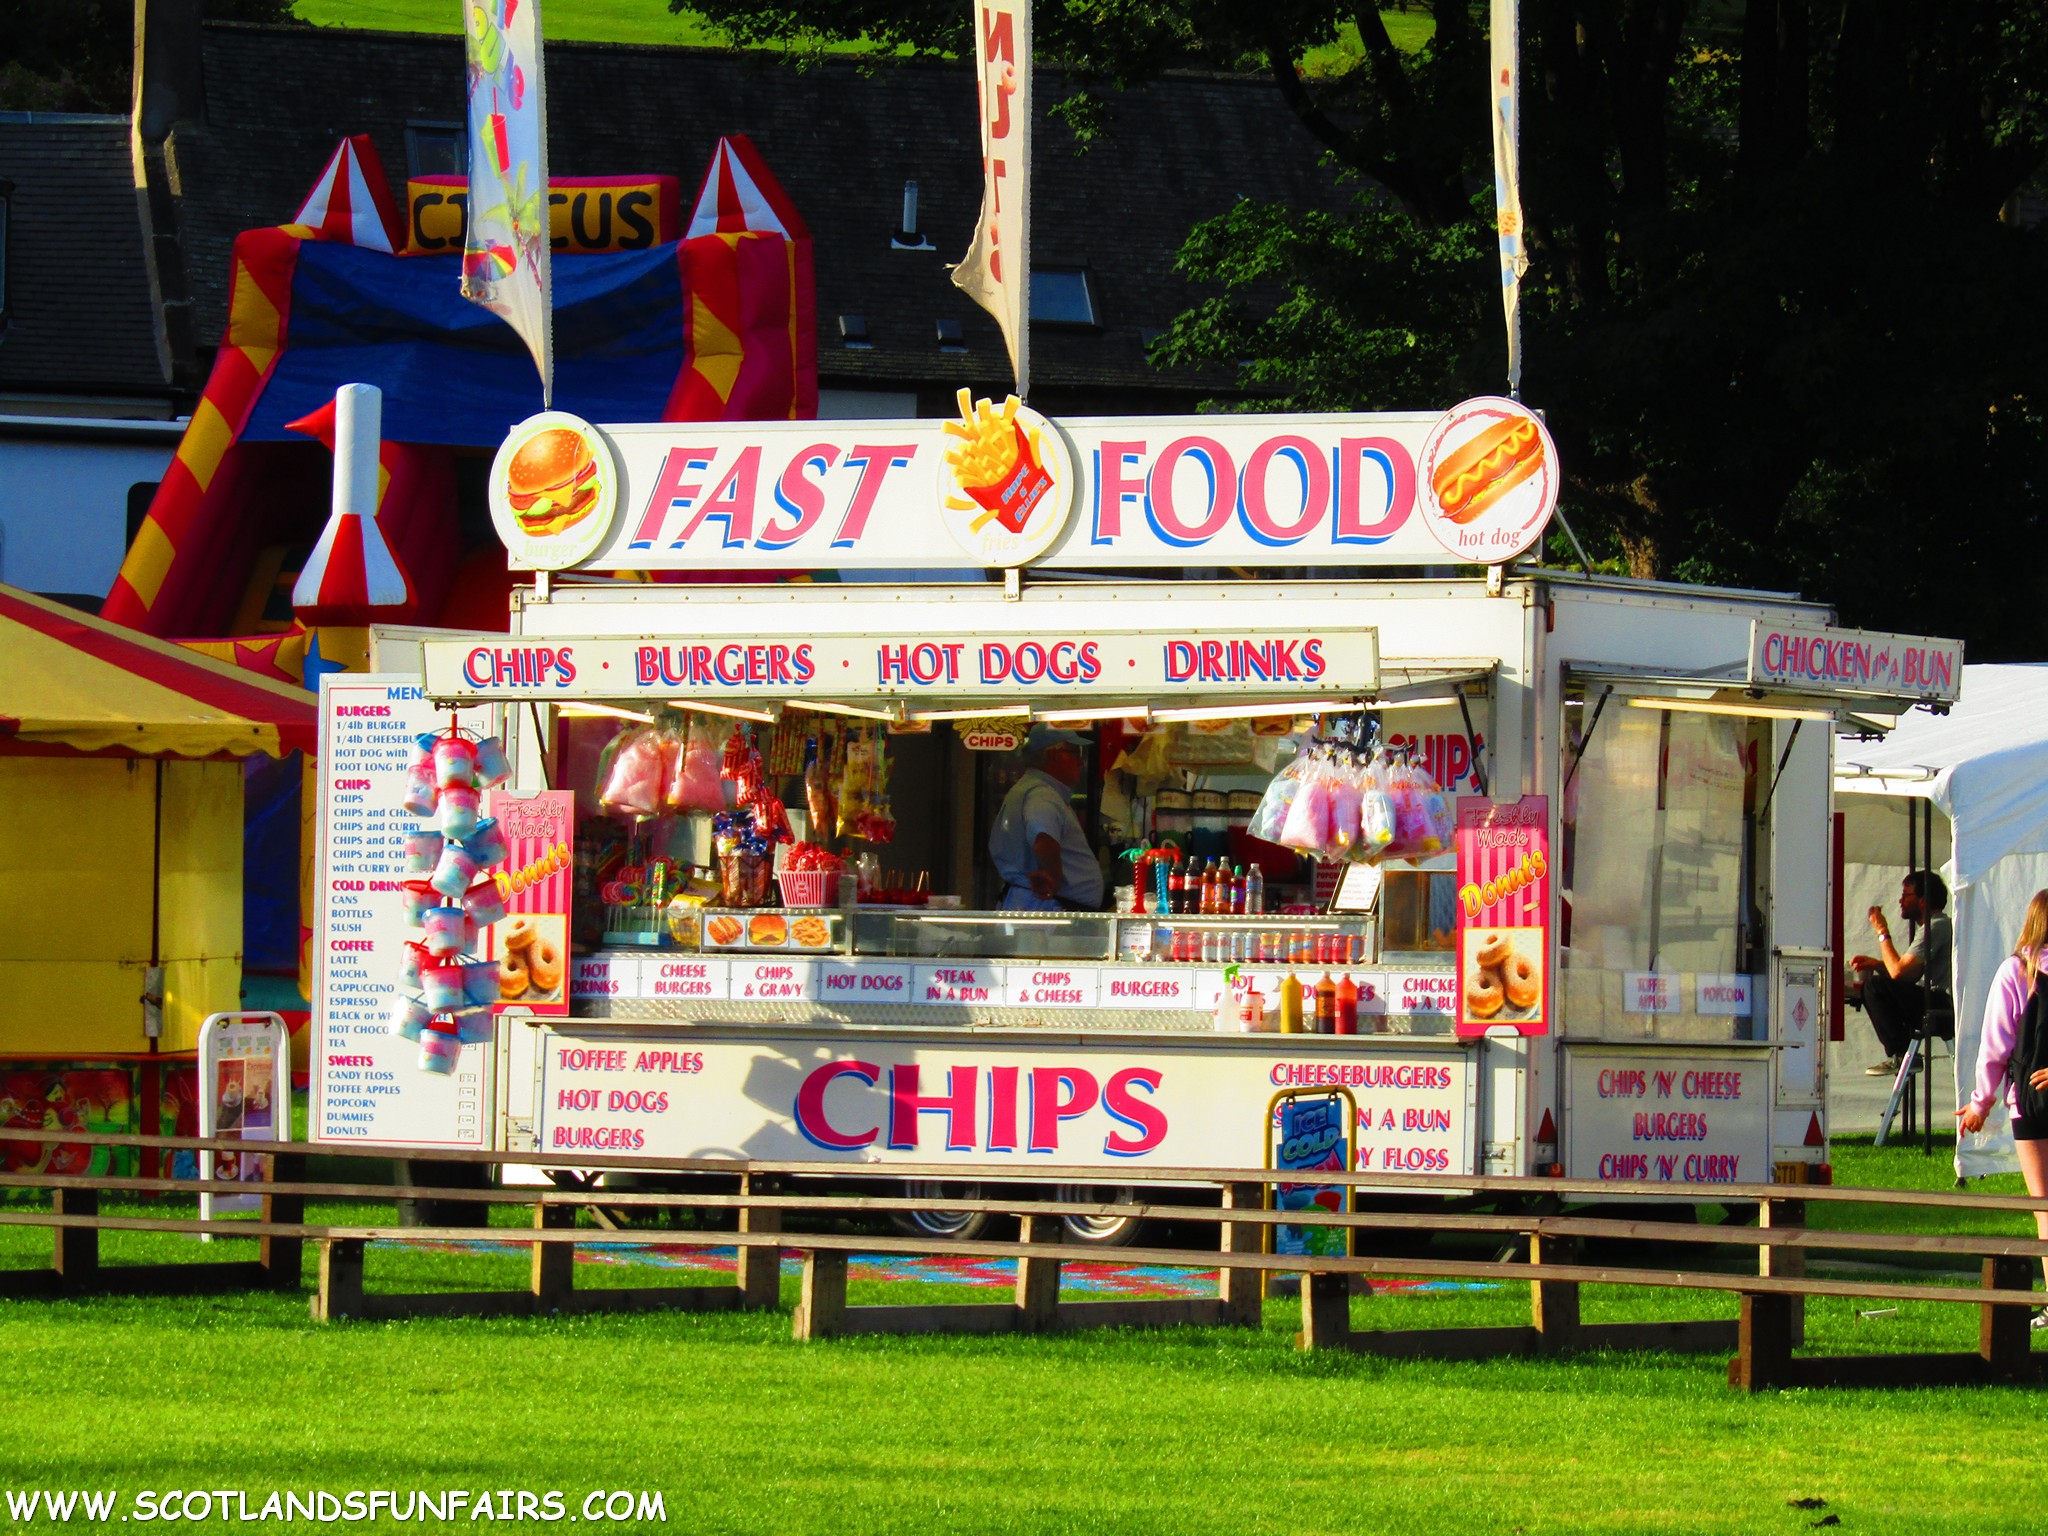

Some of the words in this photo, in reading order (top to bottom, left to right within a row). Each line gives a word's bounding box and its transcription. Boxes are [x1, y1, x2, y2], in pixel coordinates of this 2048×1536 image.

[413, 191, 655, 250] CIUS
[627, 442, 919, 551] FAST
[1090, 435, 1416, 548] FOOD
[981, 532, 1019, 554] fries
[1458, 529, 1484, 547] hot
[1490, 528, 1522, 553] dog
[524, 540, 577, 560] burger
[463, 646, 577, 689] CHIPS
[635, 643, 815, 687] BURGERS
[878, 644, 964, 684] HOT
[980, 641, 1101, 685] DOGS
[1165, 638, 1326, 685] DRINKS
[1762, 633, 1872, 684] CHICKEN
[1872, 645, 1890, 681] IN
[1886, 658, 1899, 686] A
[1901, 647, 1953, 691] BUN
[387, 687, 422, 700] MEN
[336, 705, 391, 717] BURGERS
[336, 721, 363, 731] 1/4lb
[367, 721, 406, 730] BURGER
[336, 735, 363, 745] 1/4lb
[366, 735, 414, 744] CHEESEBU
[968, 736, 1014, 748] CHIPS
[335, 749, 356, 757] HOT
[360, 749, 383, 757] DOG
[386, 748, 408, 757] with
[335, 763, 362, 771] FOOT
[365, 763, 392, 771] LONG
[335, 779, 371, 790] CHIPS
[334, 794, 364, 803] CHIPS
[334, 808, 363, 817] CHIPS
[366, 808, 385, 817] and
[498, 798, 566, 824] Freshly
[333, 822, 363, 831] CHIPS
[366, 822, 385, 831] and
[389, 823, 421, 831] CURRY
[508, 819, 555, 839] Made
[333, 836, 363, 845] CHIPS
[366, 836, 385, 845] and
[1477, 828, 1528, 849] Made
[333, 850, 363, 858] CHIPS
[366, 850, 385, 858] and
[332, 863, 354, 872] with
[358, 864, 390, 872] CURRY
[394, 865, 405, 873] or
[492, 841, 571, 904] Donuts
[332, 880, 365, 891] COLD
[369, 880, 402, 892] DRIN
[1459, 849, 1546, 918] Donuts
[332, 895, 358, 904] CANS
[331, 909, 373, 918] BOTTLES
[331, 923, 362, 932] SLUSH
[330, 940, 374, 951] COFFEE
[330, 956, 358, 964] LATTE
[330, 970, 368, 978] MOCHA
[580, 963, 609, 978] HOT
[660, 963, 707, 978] CHEESE
[755, 965, 793, 980] CHIPS
[935, 969, 976, 984] STEAK
[826, 975, 857, 990] HOT
[860, 975, 904, 991] DOGS
[1032, 972, 1071, 986] CHIPS
[1403, 977, 1456, 992] CHICKE
[1637, 977, 1667, 993] TOFFEE
[330, 983, 395, 992] CAPPUCCINO
[654, 980, 712, 995] BURGERS
[744, 982, 755, 996] &
[759, 982, 804, 997] GRAVY
[926, 987, 941, 1000] IN
[946, 988, 956, 1000] A
[960, 988, 989, 1001] BUN
[1111, 981, 1179, 997] BURGERS
[1703, 987, 1745, 1002] POPCORN
[330, 997, 378, 1006] ESPRESSO
[1019, 989, 1030, 1002] &
[1034, 989, 1083, 1003] CHEESE
[1402, 995, 1417, 1009] IN
[1420, 996, 1432, 1009] A
[1436, 996, 1456, 1010] BU
[1638, 995, 1667, 1010] APPLES
[329, 1011, 361, 1020] BLACK
[364, 1012, 375, 1020] or
[329, 1025, 350, 1033] HOT
[353, 1025, 389, 1034] CHOCO
[329, 1039, 346, 1047] TEA
[328, 1055, 374, 1067] SWEETS
[557, 1049, 628, 1071] TOFFEE
[633, 1051, 704, 1074] APPLES
[328, 1071, 361, 1079] CANDY
[365, 1072, 394, 1080] FLOSS
[1270, 1063, 1452, 1089] CHEESEBURGERS
[328, 1085, 362, 1093] TOFFEE
[366, 1086, 401, 1094] APPLES
[1597, 1069, 1647, 1098] CHIPS
[1682, 1071, 1742, 1099] CHEESE
[327, 1099, 376, 1107] POPCORN
[558, 1089, 602, 1111] HOT
[608, 1090, 669, 1113] DOGS
[327, 1112, 374, 1121] DUMMIES
[793, 1059, 1169, 1159] CHIPS
[1293, 1106, 1327, 1134] ICE
[1378, 1108, 1397, 1131] A
[1402, 1108, 1451, 1132] BUN
[1633, 1112, 1708, 1141] BURGERS
[327, 1126, 368, 1135] DONUTS
[553, 1126, 645, 1150] BURGERS
[1283, 1127, 1341, 1160] COLD
[1383, 1147, 1449, 1171] FLOSS
[1598, 1154, 1648, 1181] CHIPS
[1684, 1155, 1740, 1182] CURRY
